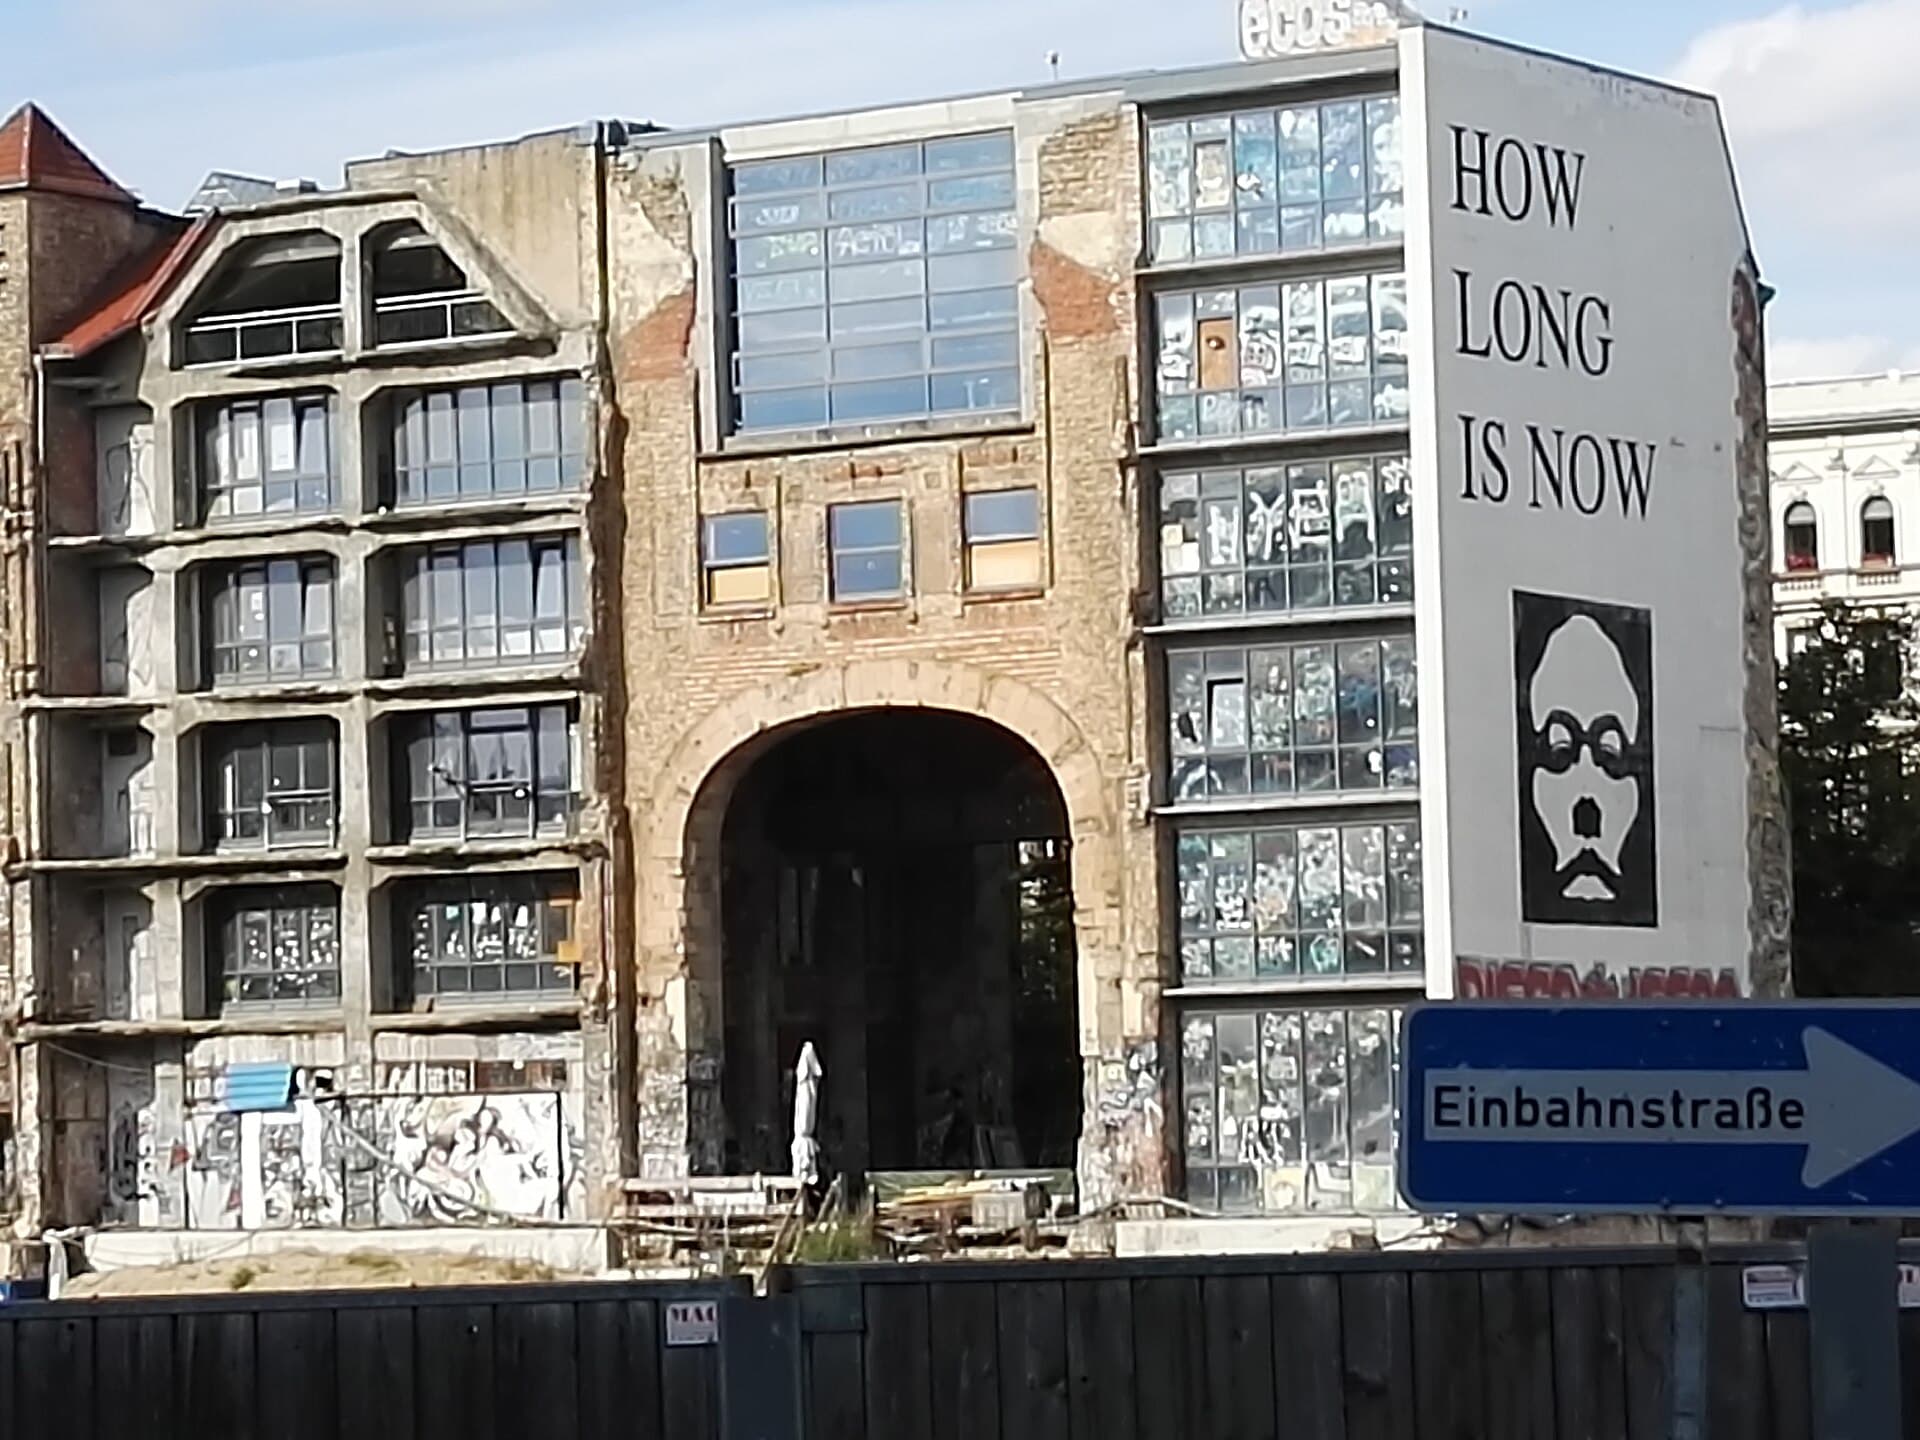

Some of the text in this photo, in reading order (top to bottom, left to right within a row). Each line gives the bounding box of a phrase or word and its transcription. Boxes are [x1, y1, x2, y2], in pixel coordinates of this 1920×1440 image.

[1448, 124, 1585, 230] HOW
[1452, 268, 1613, 377] LONG
[1458, 413, 1656, 521] IS NOW
[1433, 1085, 1805, 1130] Einbahnstraße
